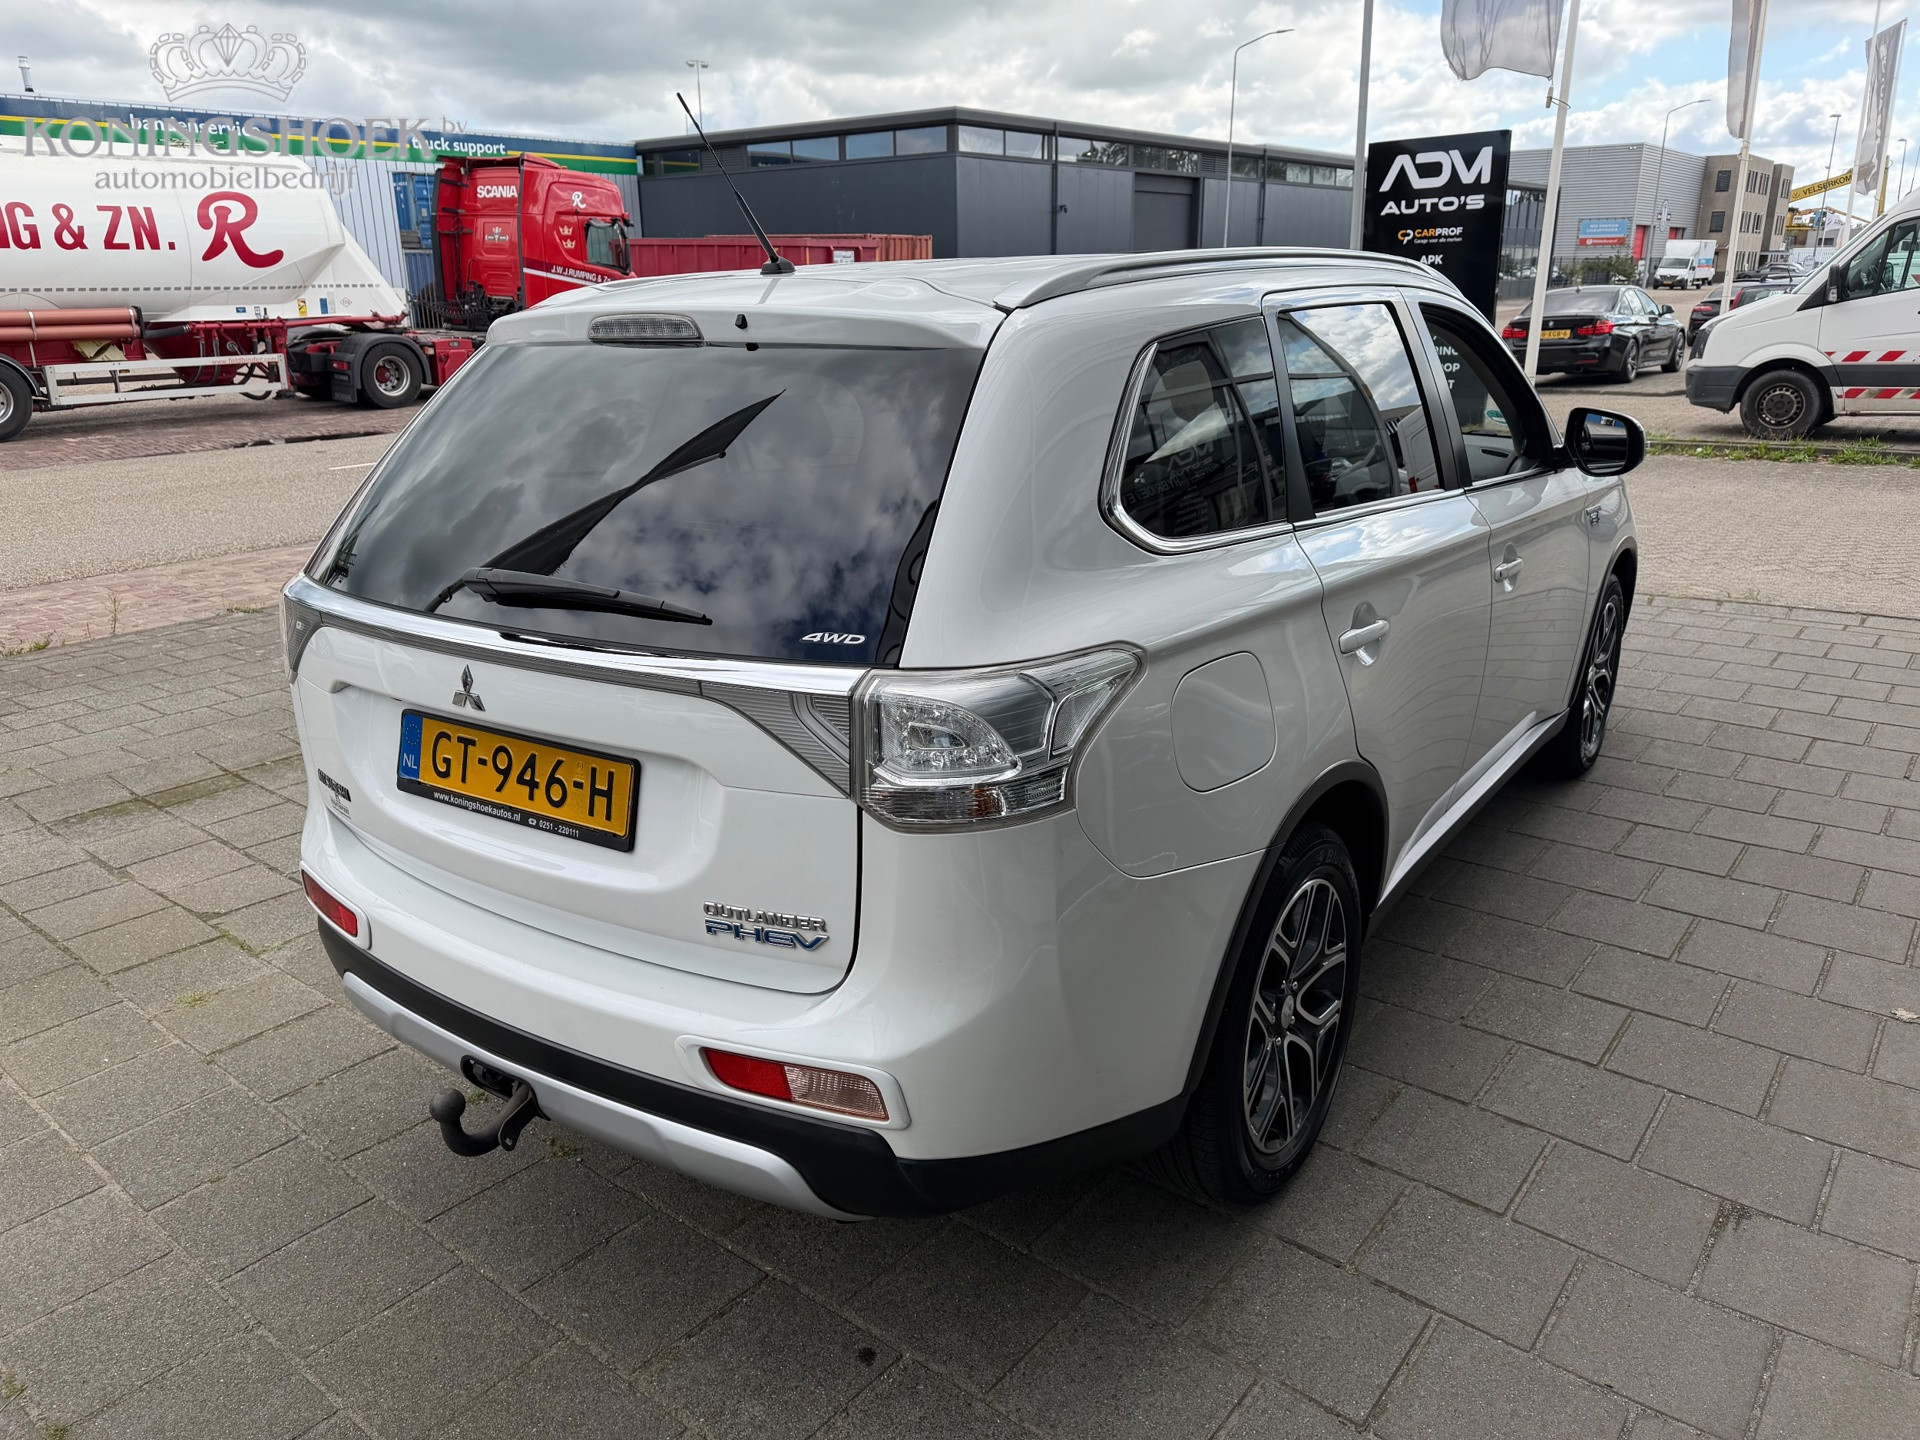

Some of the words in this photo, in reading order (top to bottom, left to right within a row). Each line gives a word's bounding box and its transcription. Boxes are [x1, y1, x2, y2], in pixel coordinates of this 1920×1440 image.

[129, 113, 261, 138] banenservic
[411, 136, 450, 151] tuck
[453, 142, 506, 157] support
[1379, 146, 1493, 192] ADM
[476, 185, 518, 198] SCANIA
[1380, 194, 1486, 216] AUTO'S
[51, 203, 89, 250] &
[96, 205, 176, 250] ZN.
[1414, 227, 1463, 238] CARPROF
[1420, 254, 1443, 265] APK
[801, 632, 866, 645] 4WD
[402, 752, 418, 769] NL
[431, 730, 615, 822] GT-946-H
[433, 790, 521, 822] www.koningshoekautos.nl
[538, 821, 553, 830] 0251
[558, 825, 579, 837] 220111
[703, 901, 828, 932] OUTLANDER
[704, 917, 830, 951] PHEV
